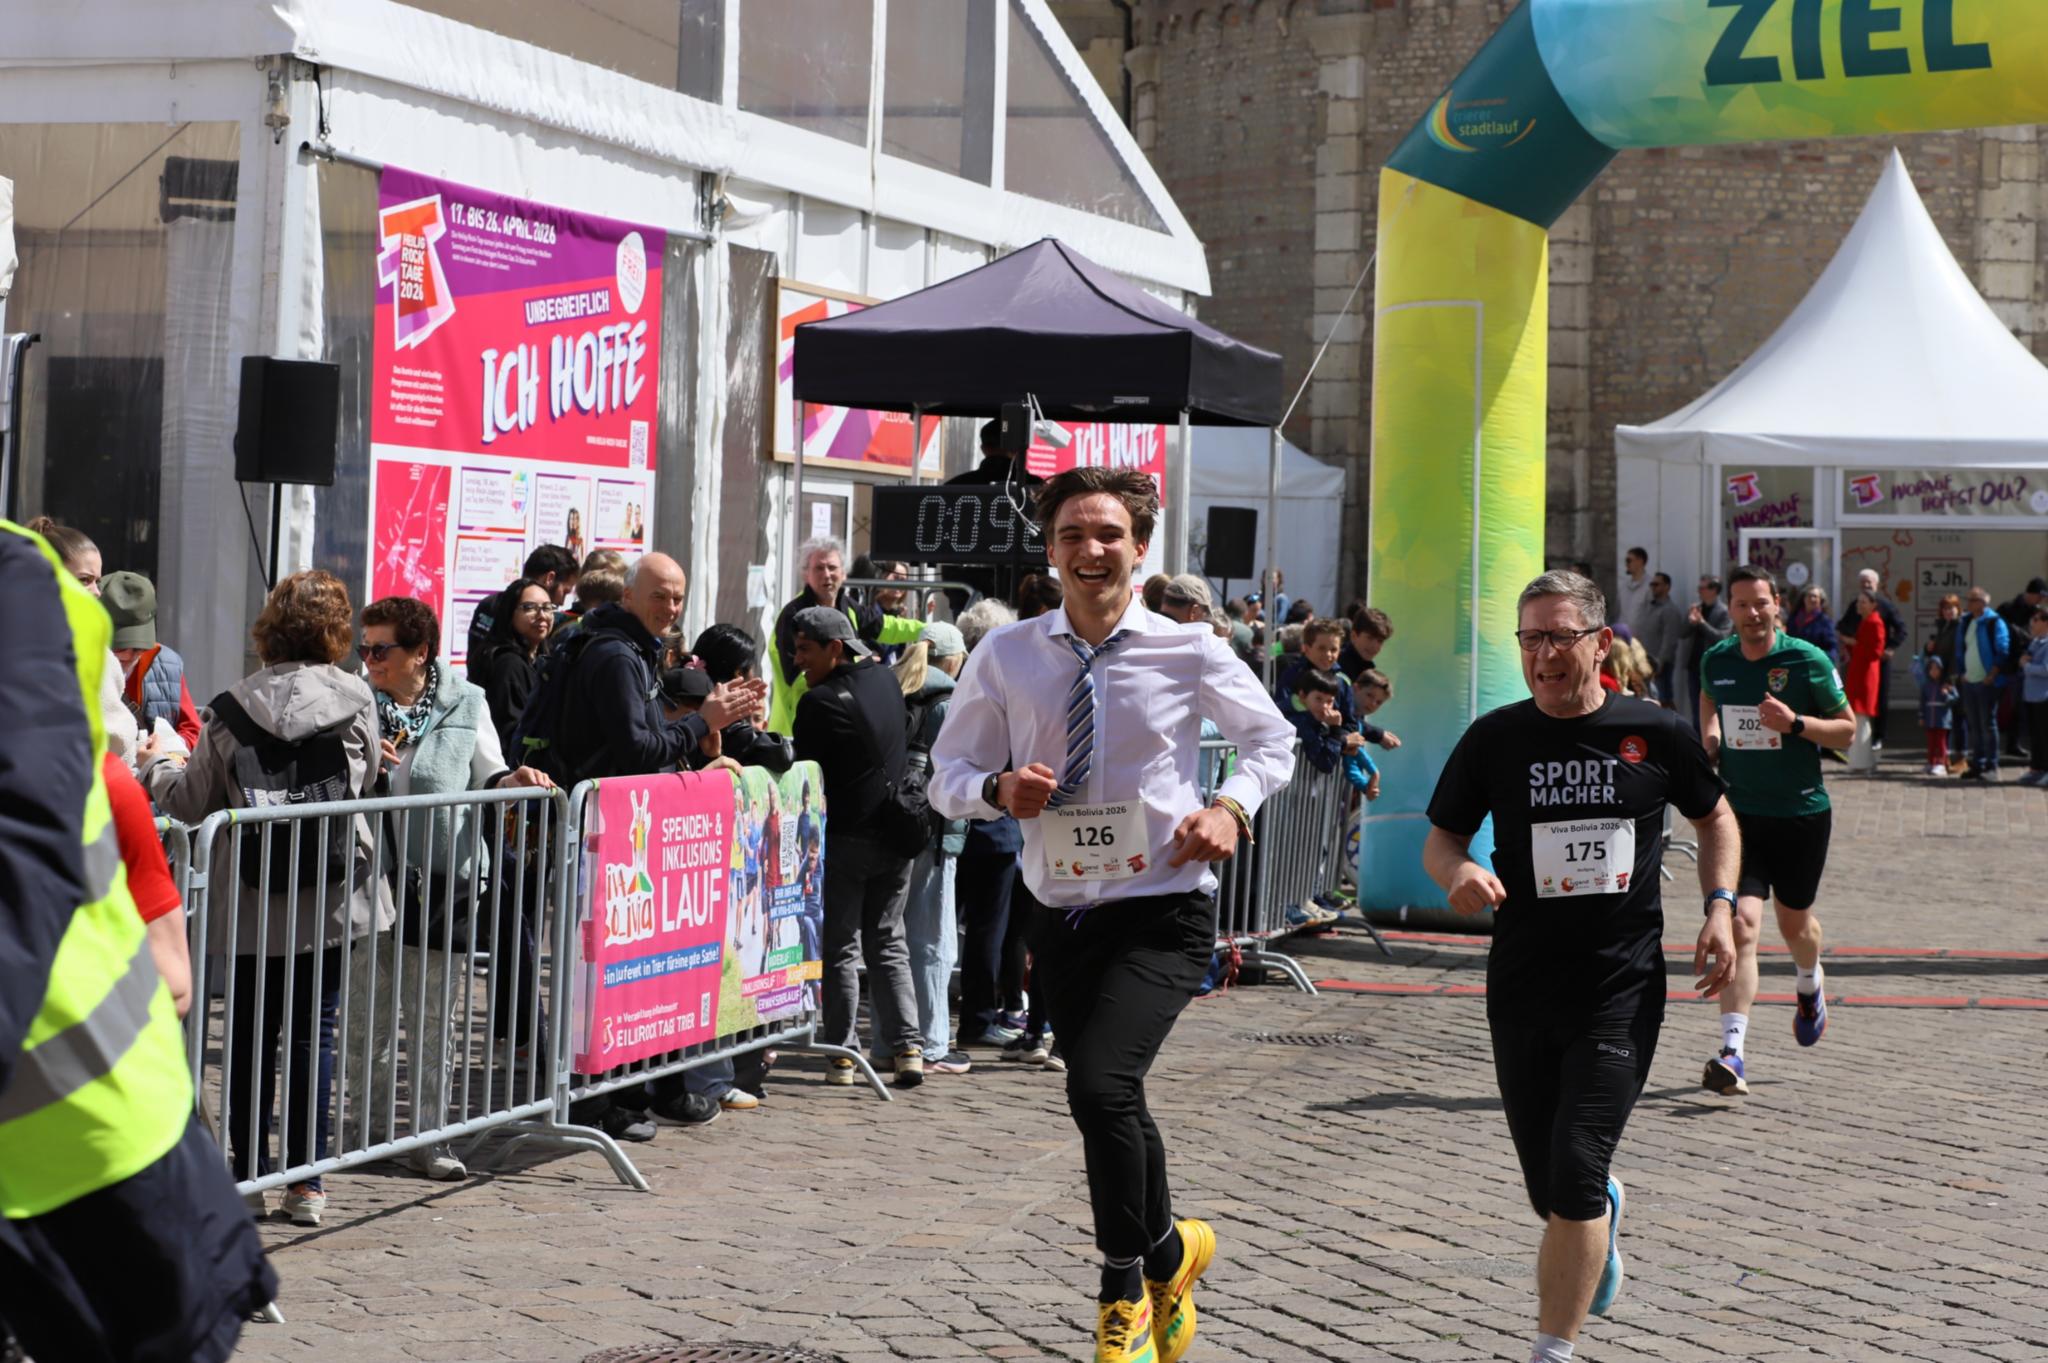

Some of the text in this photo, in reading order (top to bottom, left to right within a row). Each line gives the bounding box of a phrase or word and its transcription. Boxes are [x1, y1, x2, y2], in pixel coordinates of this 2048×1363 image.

[1704, 0, 1992, 87] ZIEL
[1459, 120, 1518, 136] stadtlauf
[450, 203, 466, 225] 17.
[467, 206, 485, 230] BIS
[485, 211, 502, 234] 26.
[503, 215, 533, 241] APRIL
[533, 222, 557, 246] 2026
[401, 233, 426, 250] HEILIG
[401, 247, 424, 266] ROCK
[400, 262, 424, 283] TAGE
[400, 280, 424, 301] 2026
[525, 289, 610, 325] UNBEGREIFLICH
[481, 319, 648, 443] ICH HOFFE
[1922, 570, 1968, 587] 3. Jh.
[1738, 719, 1762, 731] 202
[1529, 760, 1618, 787] SPORT
[1530, 785, 1623, 808] MACHER.
[1057, 806, 1127, 817] Viva Bolivia 2026
[662, 812, 722, 843] SPENDEN- &
[1073, 826, 1115, 847] 126
[1551, 822, 1621, 834] Viva Bolivia 2026
[662, 840, 722, 872] INKLUSIONS
[1565, 841, 1606, 862] 175
[662, 868, 723, 933] LAUF
[676, 1012, 695, 1033] TRIER
